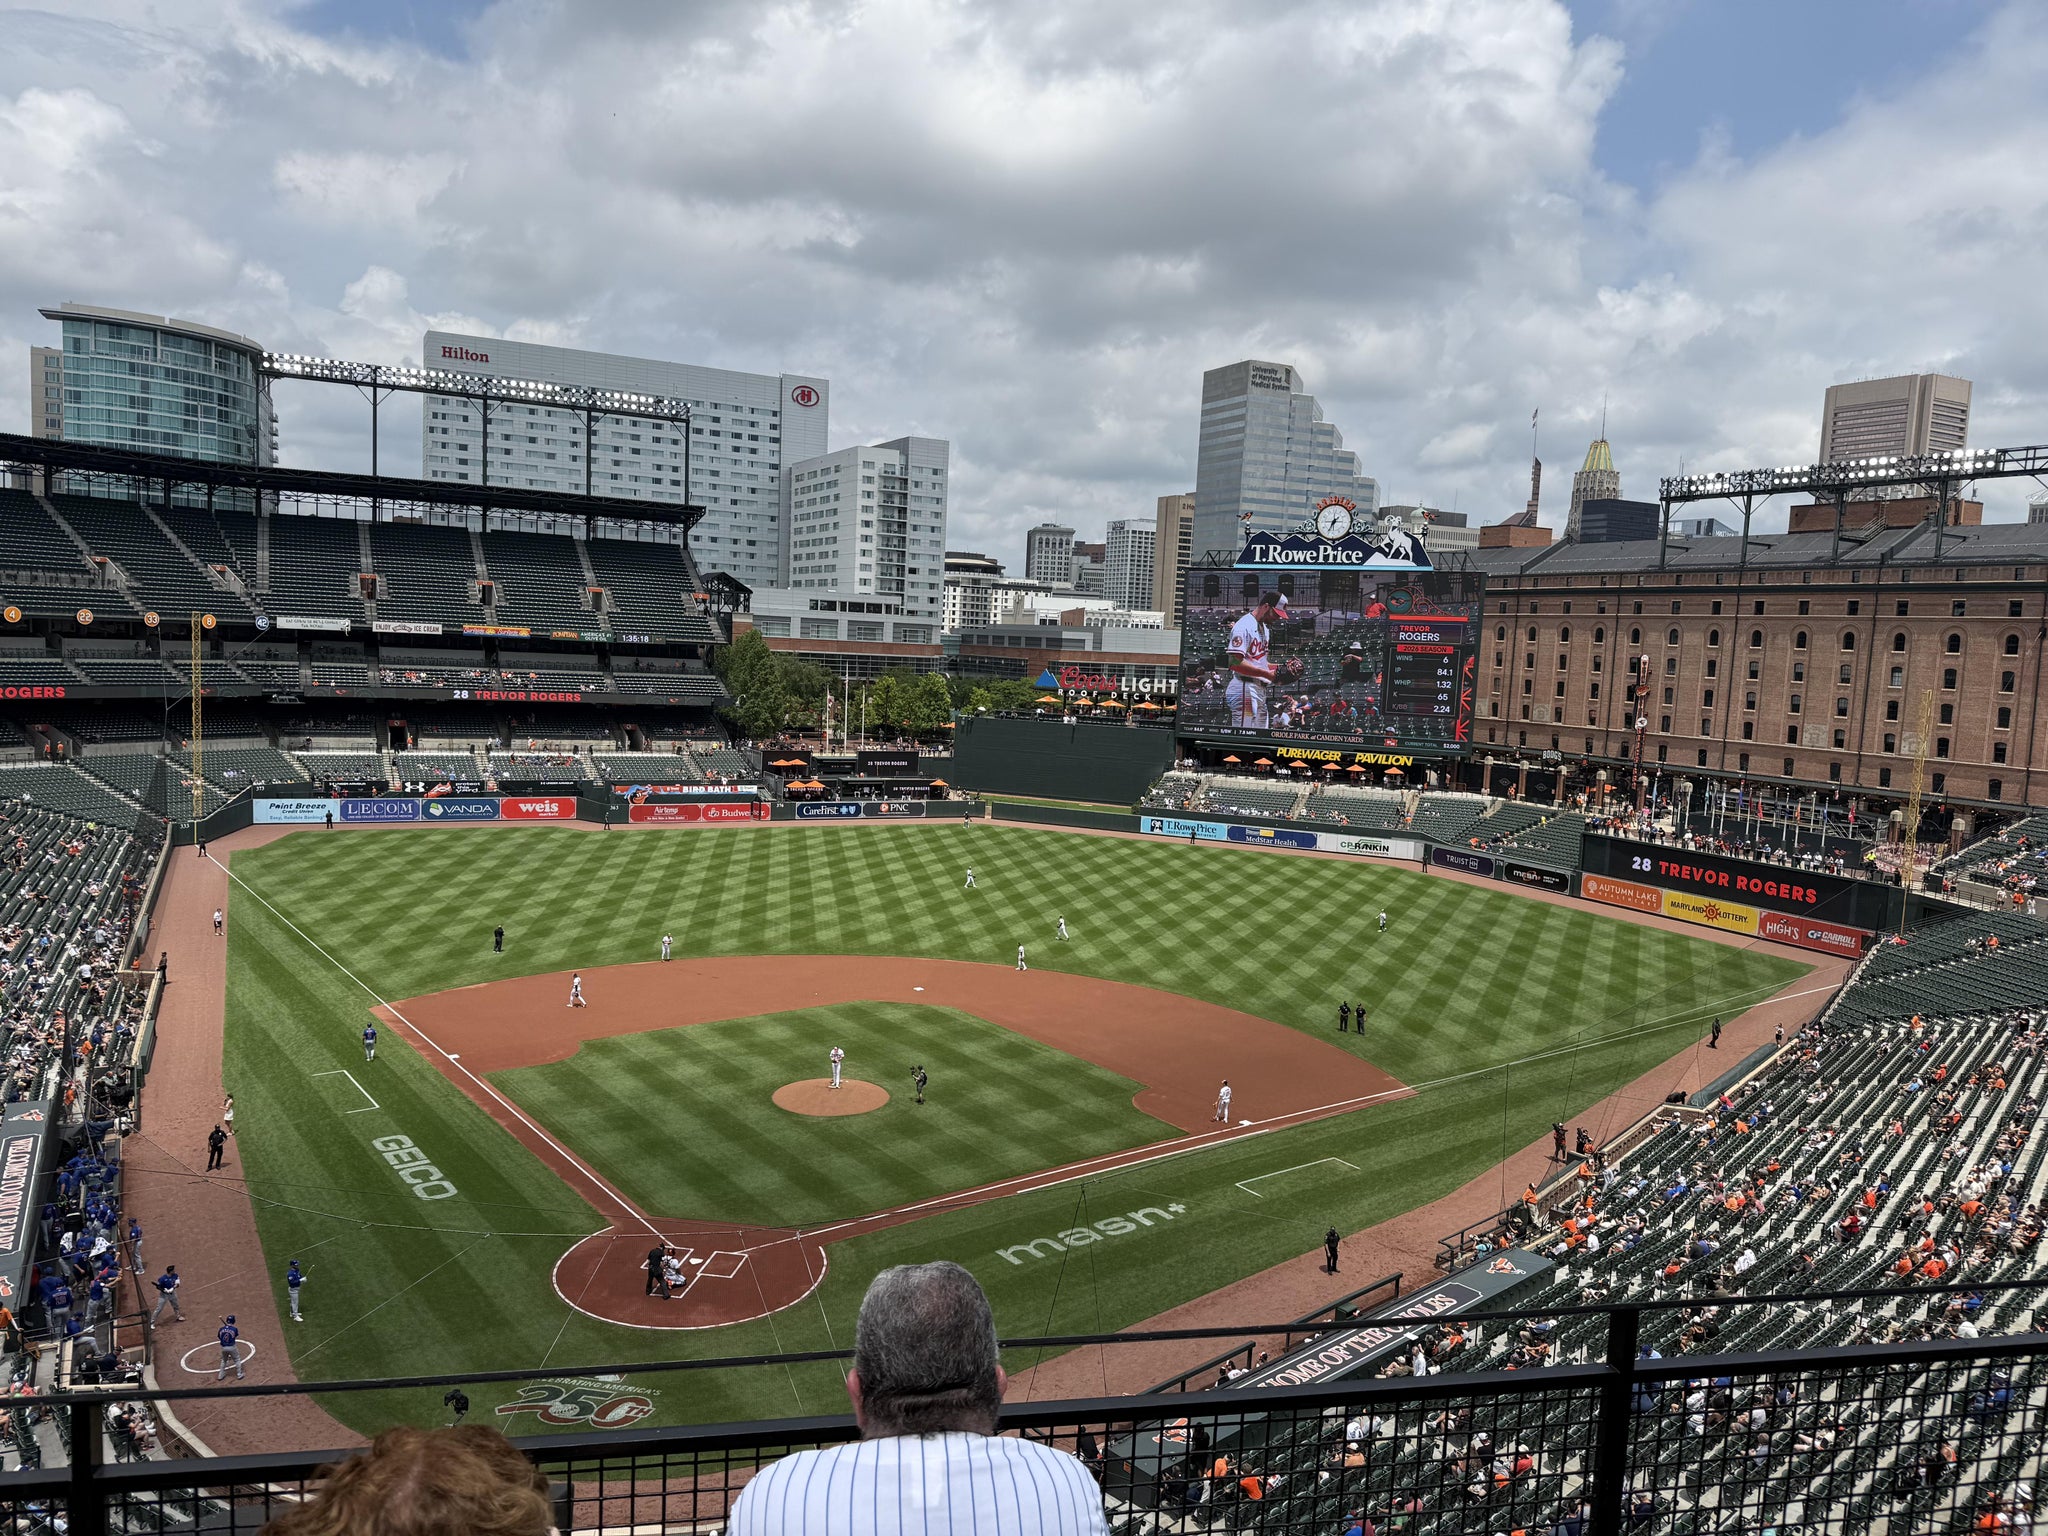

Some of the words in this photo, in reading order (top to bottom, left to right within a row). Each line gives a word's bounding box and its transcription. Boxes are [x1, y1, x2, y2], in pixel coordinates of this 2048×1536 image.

[441, 345, 490, 363] Hilton
[1251, 365, 1278, 376] University
[1251, 379, 1270, 390] Medical
[1271, 382, 1290, 391] System
[1257, 374, 1282, 384] Maryland
[9, 610, 16, 620] 4
[79, 612, 91, 621] 22
[147, 614, 158, 624] 33
[206, 617, 212, 626] 8
[256, 618, 268, 627] 42
[375, 623, 391, 631] ENJOY
[423, 625, 440, 633] CREAM
[622, 634, 649, 643] 1:35:18
[1399, 632, 1440, 641] ROGERS
[1443, 656, 1449, 664] 6
[1436, 668, 1453, 676] 84.1
[1059, 665, 1118, 691] Coors
[1121, 676, 1179, 694] LIGHT
[1436, 681, 1452, 689] 1.32
[453, 690, 469, 699] 28
[474, 690, 526, 700] TREVOR
[530, 691, 582, 702] ROGERS
[1058, 688, 1098, 698] ROOF
[1111, 691, 1151, 701] DECK
[1437, 693, 1448, 701] 65
[1433, 705, 1450, 713] 2.24
[1270, 731, 1294, 739] ORIOLE
[1294, 732, 1310, 740] PARK
[1316, 733, 1344, 742] CAMDEN
[1343, 735, 1364, 743] YARDS
[1276, 747, 1342, 762] PUREWAGER
[1355, 752, 1413, 767] PAVILION
[682, 785, 705, 793] BIRD
[707, 785, 731, 793] BATH
[347, 803, 413, 814] LECOM
[444, 804, 493, 813] VANDA
[518, 800, 559, 813] weis
[803, 804, 840, 816] CareFirst
[890, 803, 909, 812] PNC
[1245, 835, 1273, 844] MedStar
[1274, 838, 1298, 847] Health
[1446, 854, 1469, 866] TRUIST
[1631, 856, 1652, 872] 28
[1658, 860, 1730, 887] TREVOR
[1736, 875, 1818, 904] ROGERS
[1598, 883, 1634, 897] AUTUMN
[1635, 890, 1658, 903] LAKE
[1670, 900, 1705, 914] MARYLAND
[1766, 921, 1799, 941] HIGH'S
[1821, 931, 1856, 945] CARROLL
[2, 1137, 34, 1180] WELCOME
[371, 1134, 458, 1201] GEICO
[1, 1176, 26, 1192] TO
[0, 1190, 24, 1224] ORIOLE
[1318, 1343, 1353, 1366] OF
[1344, 1327, 1393, 1353] THE
[601, 1383, 663, 1397] AMERICA'S
